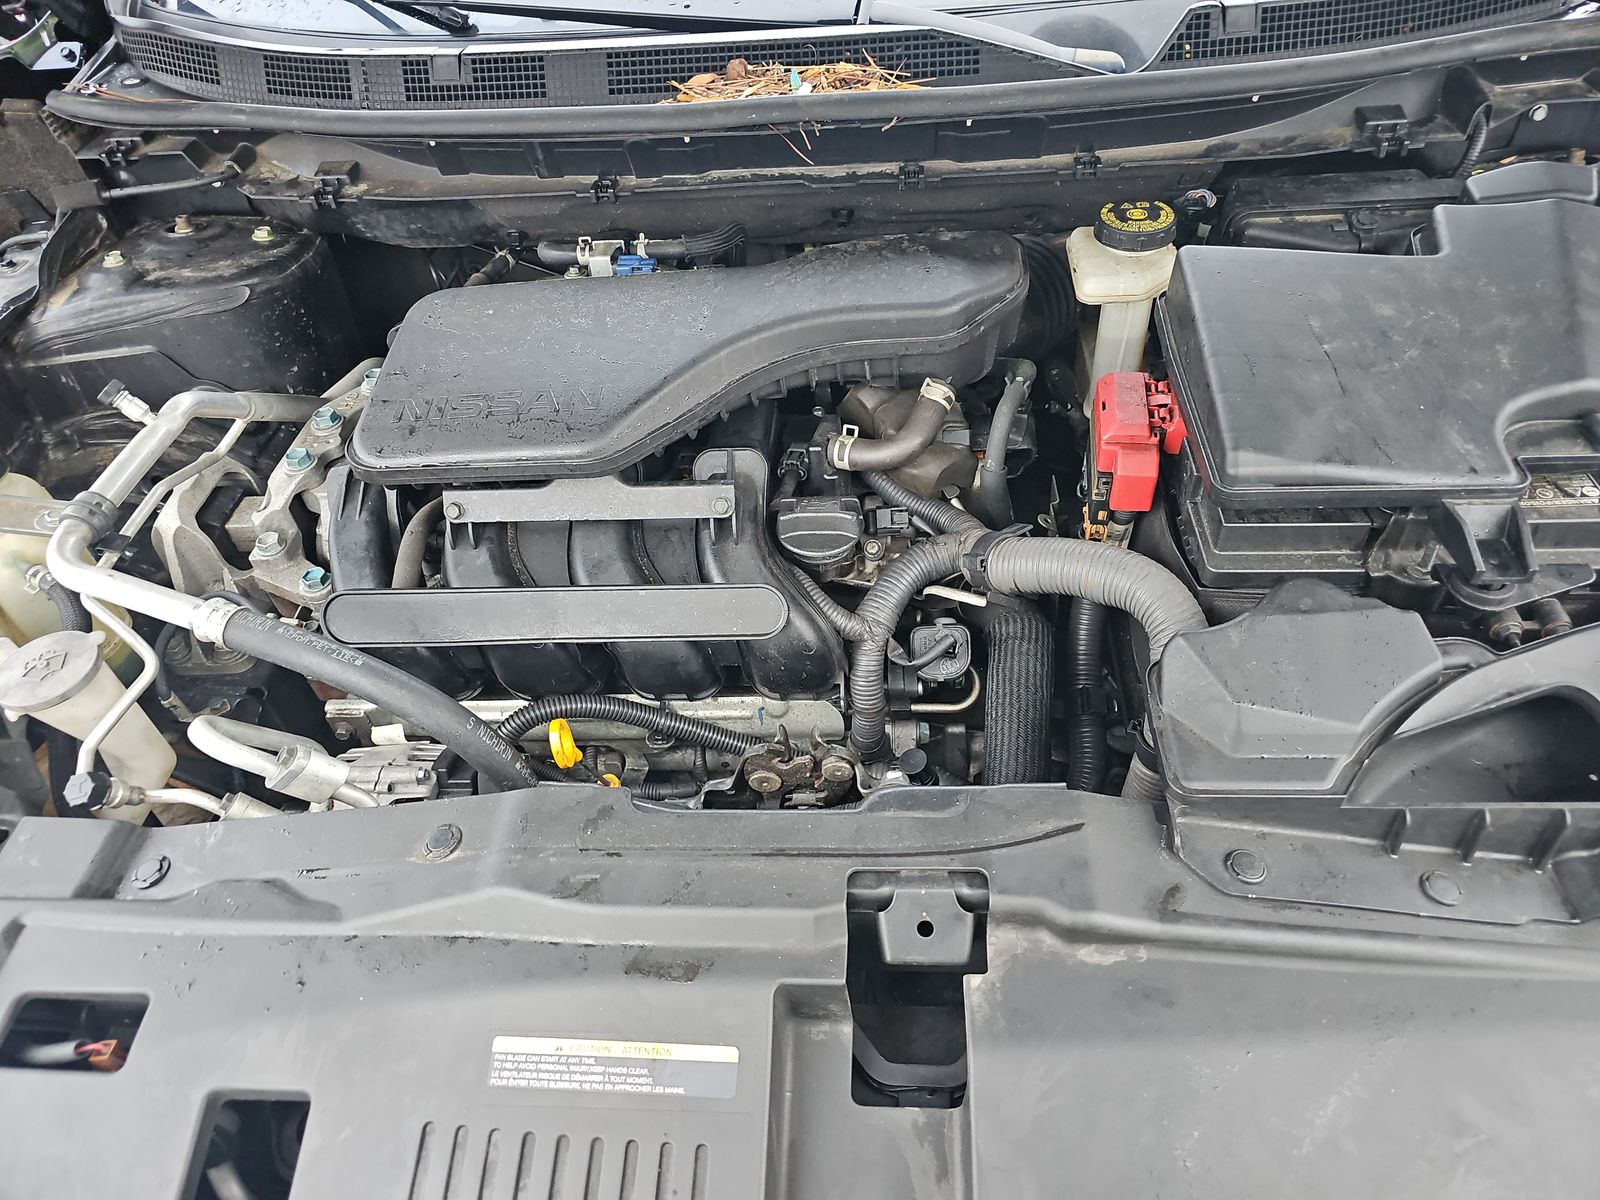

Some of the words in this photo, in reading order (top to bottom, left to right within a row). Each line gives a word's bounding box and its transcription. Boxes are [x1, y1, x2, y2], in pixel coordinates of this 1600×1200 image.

[391, 386, 604, 423] NISSAN
[569, 1044, 612, 1054] CAUTION
[622, 1046, 672, 1056] ATTENTION
[567, 1056, 581, 1064] ANY
[537, 1063, 568, 1071] PERSONAL
[606, 1066, 627, 1074] HANDS
[628, 1067, 649, 1075] CLEAR.
[500, 1071, 537, 1079] VENTILATEUR
[610, 1075, 626, 1083] TOUT
[626, 1076, 653, 1084] MOMENT.
[490, 1078, 507, 1086] POUR
[529, 1080, 548, 1088] TOUTE
[614, 1084, 651, 1092] APPROCHER
[652, 1085, 664, 1093] LES
